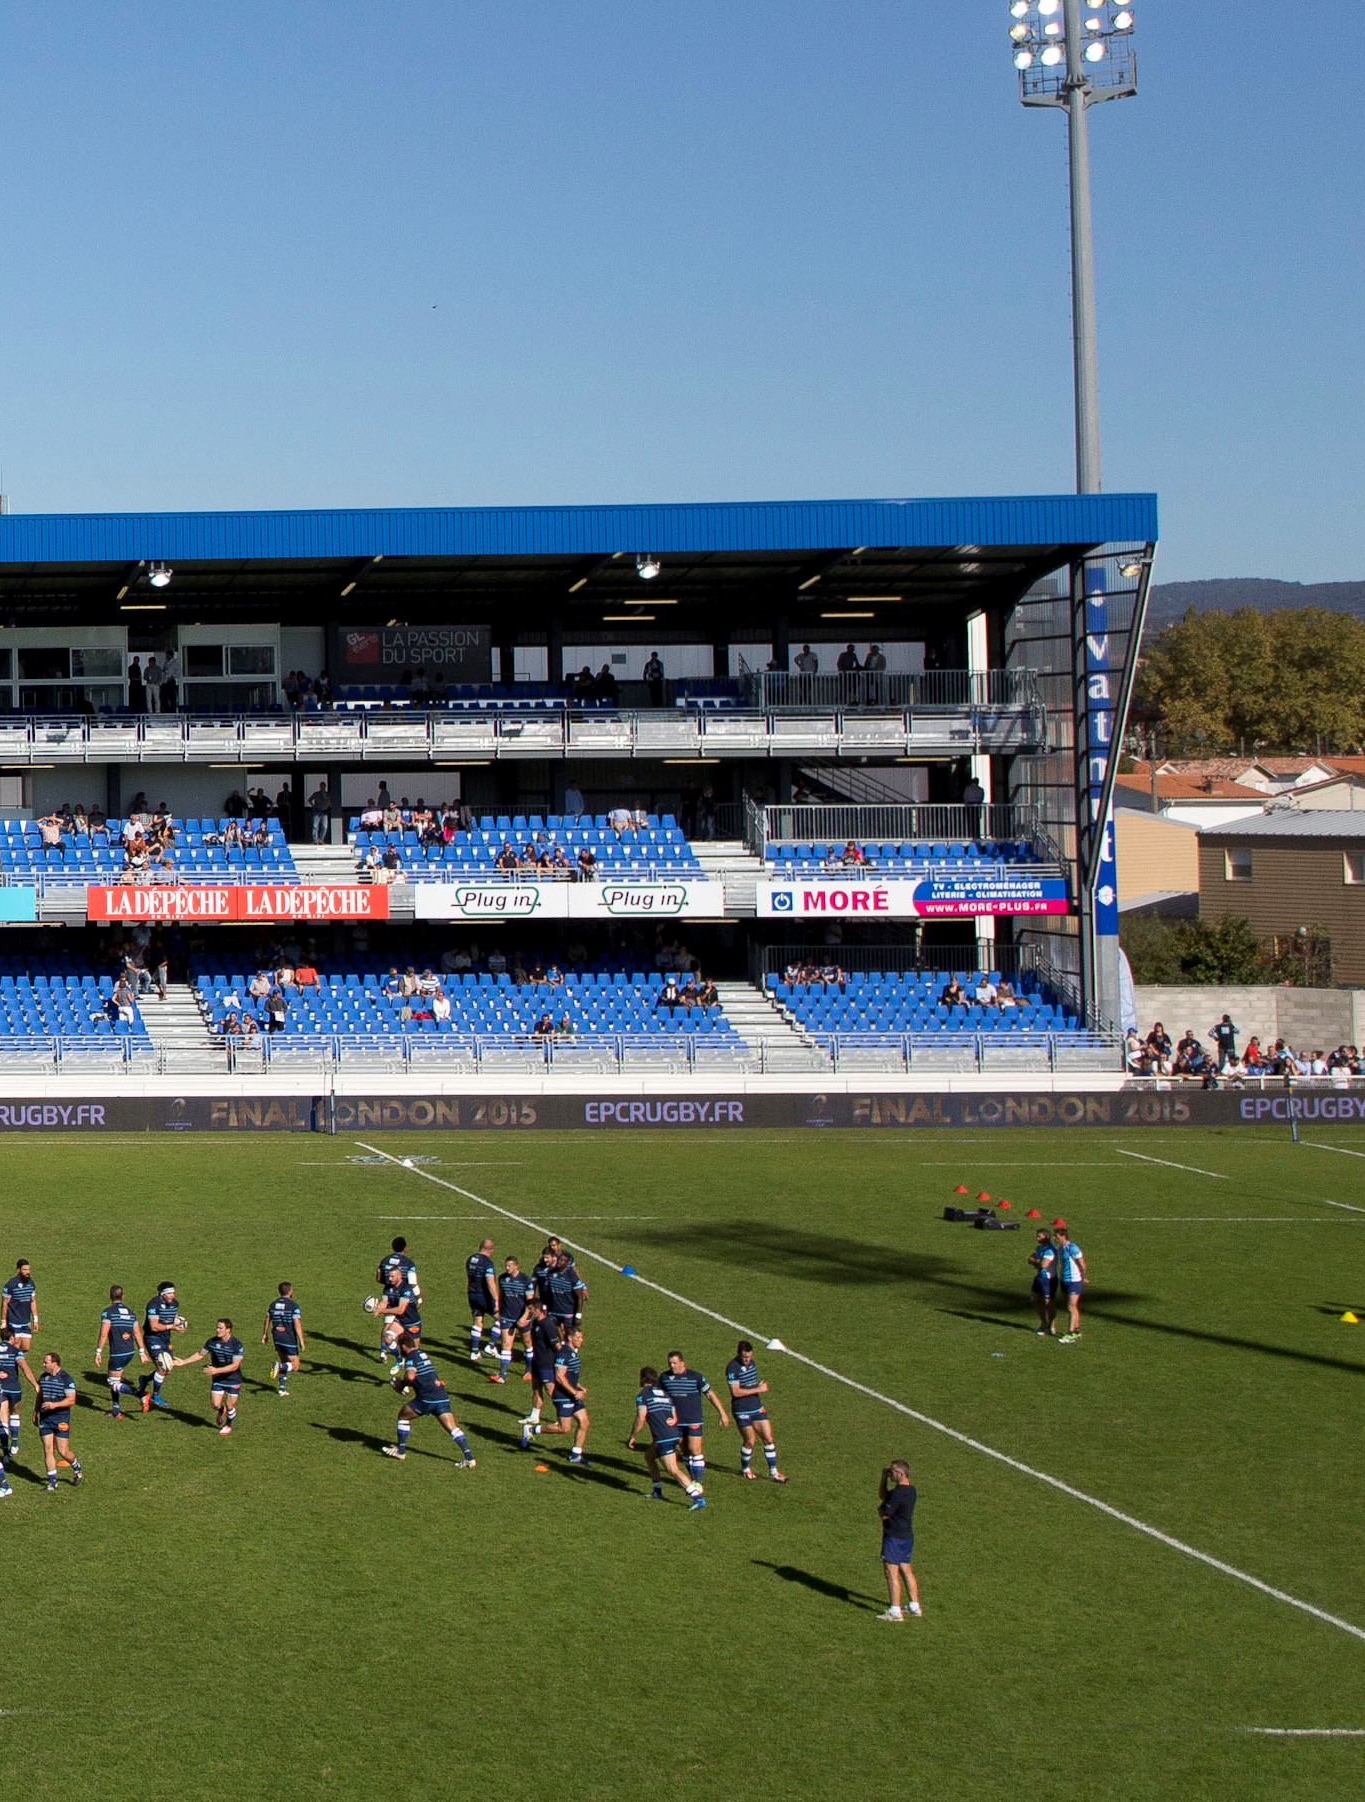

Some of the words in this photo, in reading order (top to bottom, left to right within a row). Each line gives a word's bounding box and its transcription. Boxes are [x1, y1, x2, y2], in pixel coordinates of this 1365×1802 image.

[382, 632, 404, 647] LA
[408, 631, 479, 647] PASSION
[382, 649, 406, 663] DU
[410, 648, 465, 663] SPORT
[464, 892, 507, 910] Plug
[513, 892, 532, 907] in
[610, 891, 654, 909] Plug
[660, 891, 679, 906] in
[803, 885, 889, 911] MORÉ
[931, 891, 966, 899] LITERIE
[975, 890, 1044, 898] CLIMATISATION
[210, 1102, 305, 1126] FINAL
[315, 1100, 460, 1126] LONDON
[470, 1099, 537, 1125] 2015
[584, 1101, 744, 1123] EPCRUGBY.FR
[852, 1098, 951, 1124] FINAL
[960, 1097, 1111, 1123] LONDON
[1122, 1096, 1191, 1122] 2015
